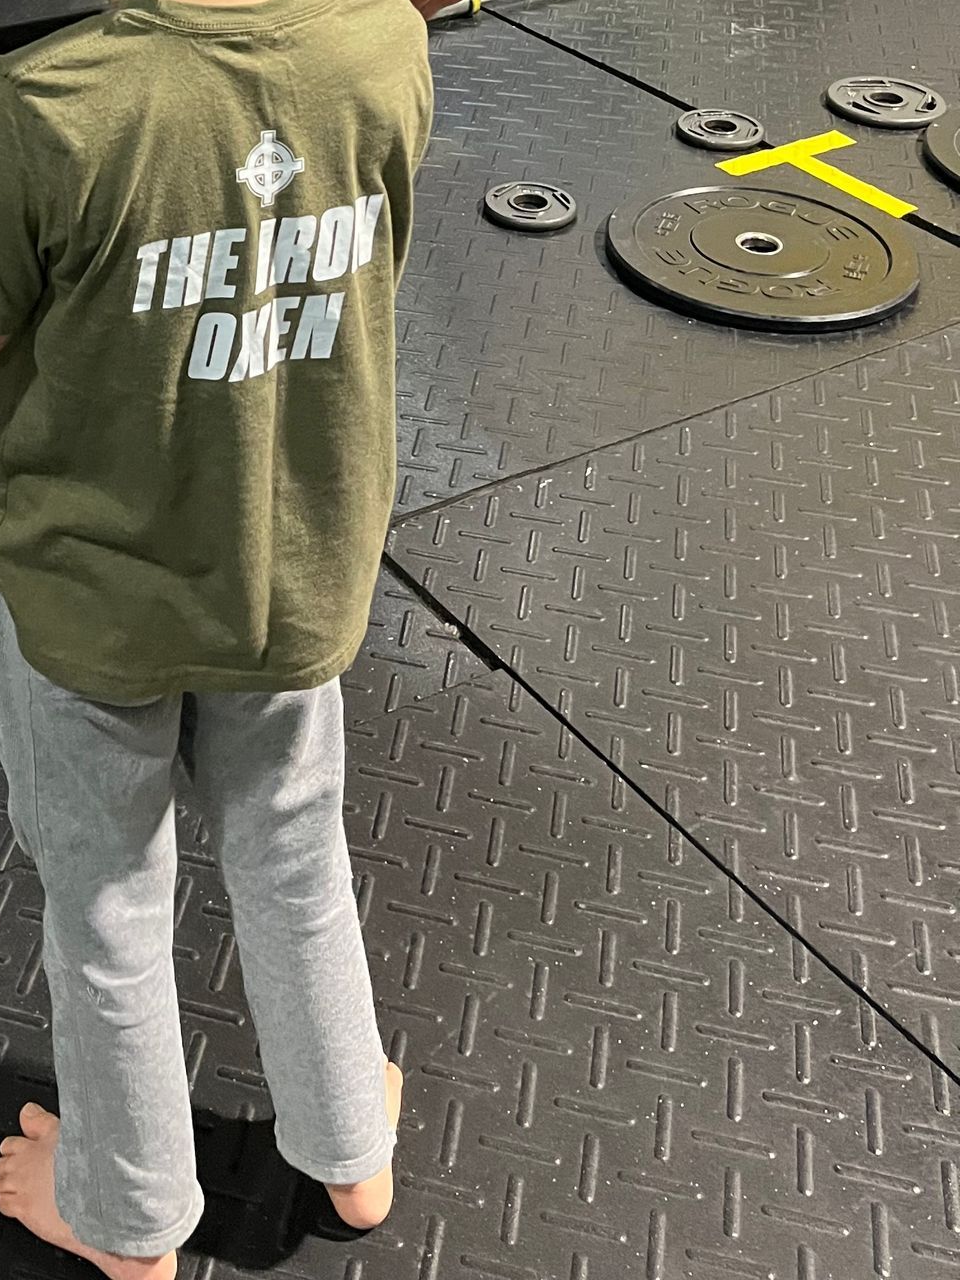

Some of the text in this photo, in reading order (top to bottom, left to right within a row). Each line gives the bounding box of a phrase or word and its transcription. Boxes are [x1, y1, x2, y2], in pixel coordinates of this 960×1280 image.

[132, 193, 384, 313] THE IRON
[683, 195, 860, 241] ROGUE
[651, 246, 842, 300] ROGUE
[187, 291, 346, 383] OXEN
